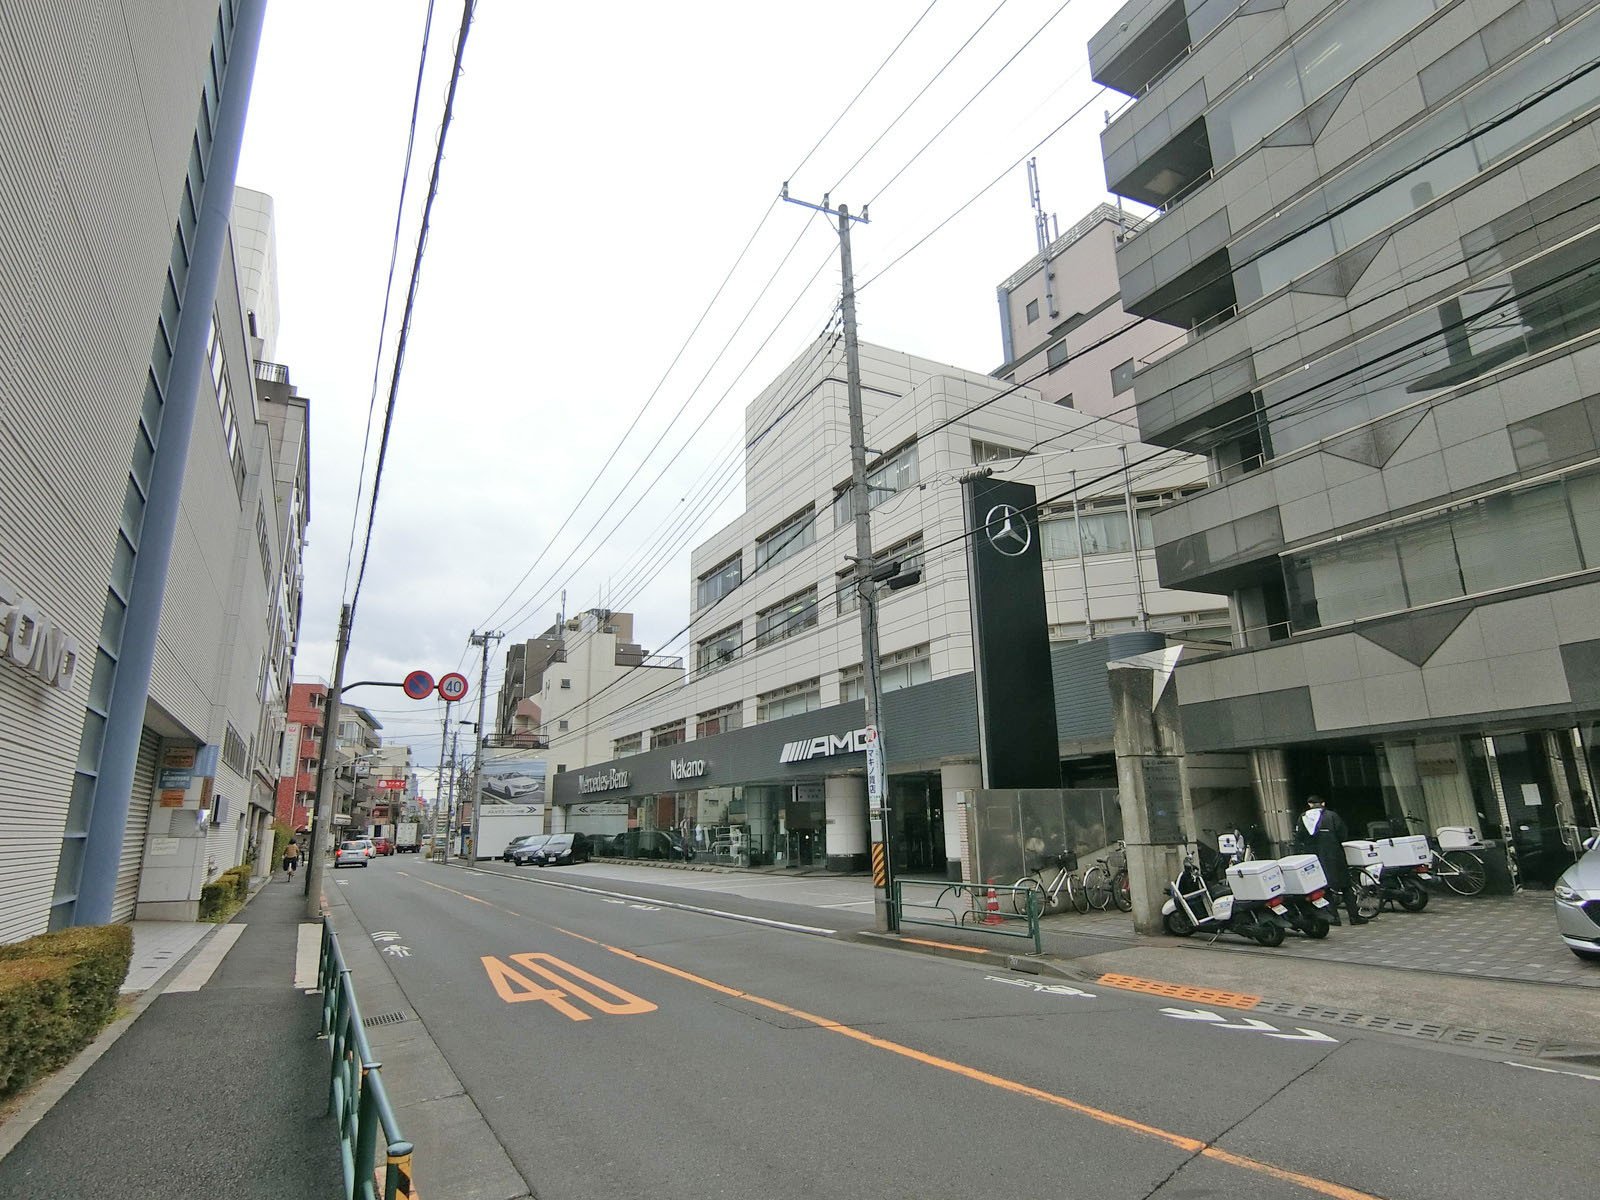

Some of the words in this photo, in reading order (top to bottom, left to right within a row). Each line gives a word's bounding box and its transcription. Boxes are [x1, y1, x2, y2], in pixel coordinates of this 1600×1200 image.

[445, 680, 462, 693] 40
[577, 768, 629, 794] Mercedes-Benz
[670, 759, 704, 780] Nakano
[480, 952, 658, 1021] 40
